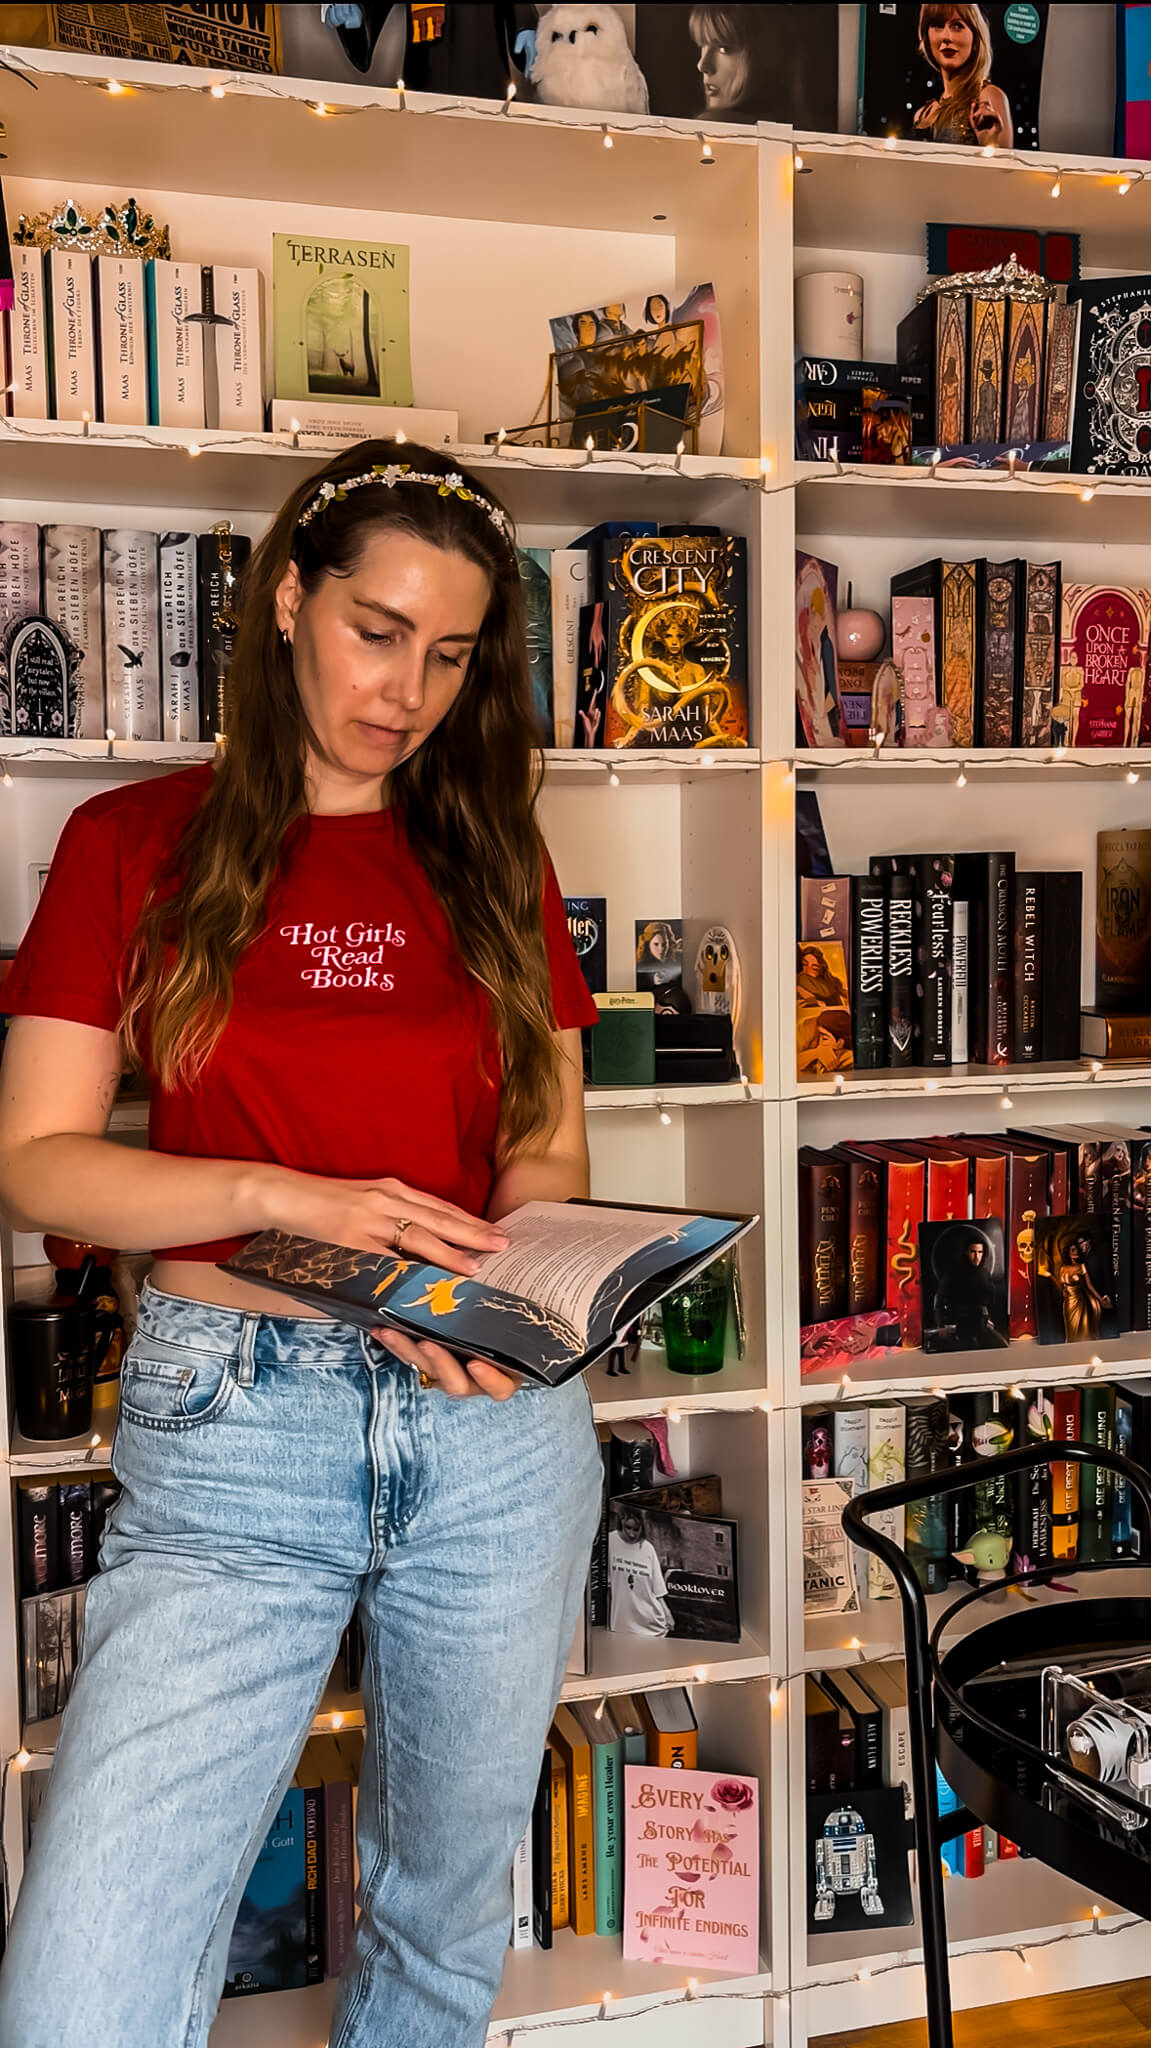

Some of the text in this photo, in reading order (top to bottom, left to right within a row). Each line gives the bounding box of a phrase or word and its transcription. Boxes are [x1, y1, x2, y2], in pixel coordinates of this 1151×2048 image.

[170, 34, 273, 73] MURDERED
[222, 38, 271, 62] FAMILY
[288, 243, 395, 269] TERRASEN
[66, 276, 74, 307] GLASS
[231, 291, 240, 321] GLASS
[62, 302, 75, 318] of
[16, 271, 33, 391] MAAS THRONE of GLASS
[68, 318, 77, 360] THRONE
[114, 281, 129, 400] MAAS THRONE of GLASS
[176, 327, 184, 368] THRONE
[233, 332, 242, 372] THRONE
[70, 370, 79, 396] MAAS
[235, 382, 243, 407] MAAS
[9, 539, 21, 571] HÖFE
[68, 543, 78, 573] HÖFE
[629, 549, 719, 565] CRESCENT
[58, 565, 67, 602] REICH
[164, 571, 173, 608] REICH
[211, 572, 219, 607] REICH
[633, 566, 715, 595] CITY
[69, 578, 79, 622] SIEBEN
[117, 569, 126, 628] DAS REICH
[128, 548, 139, 647] DER SIEBEN HÖFE
[175, 550, 186, 648] DER SIEBEN HÖFE
[567, 619, 575, 664] CRESCENT
[1086, 624, 1130, 644] ONCE
[1086, 643, 1114, 654] UPON
[1085, 654, 1128, 671] BROKEN
[1085, 668, 1127, 686] HEART
[136, 678, 144, 711] MAAS
[170, 683, 179, 721] SARAH
[182, 680, 191, 712] MAAS
[641, 705, 713, 723] SARAH J.
[1088, 718, 1117, 729] STEPHANIE
[650, 725, 703, 742] MAAS
[997, 879, 1008, 930] CRIMSON
[1024, 887, 1036, 929] REBEL
[1105, 888, 1140, 912] IRON
[280, 922, 406, 947] Hot Girls
[889, 899, 913, 977] RECKLESS
[927, 889, 952, 958] Fearless
[311, 945, 384, 971] Read
[860, 898, 883, 993] POWERLESS
[997, 933, 1008, 973] MOTH
[1023, 934, 1036, 982] WITCH
[953, 935, 967, 990] POWERFUL
[300, 966, 395, 991] Books
[1111, 1223, 1121, 1253] FALLEN
[807, 1506, 826, 1515] STAR
[1065, 1492, 1074, 1511] DIE
[1095, 1487, 1105, 1506] DIE
[1039, 1498, 1048, 1557] HARKNESS
[667, 1581, 725, 1598] BOOKLOVER
[804, 1576, 846, 1593] TANIC
[898, 1730, 906, 1767] ESCAPE
[605, 1754, 615, 1790] Healer
[576, 1773, 589, 1818] IMAGINE
[605, 1791, 615, 1814] own
[631, 1783, 704, 1811] EVERY
[306, 1816, 317, 1838] POOR
[605, 1816, 616, 1842] your
[638, 1820, 694, 1842] STORY
[271, 1836, 295, 1849] Gott
[306, 1839, 317, 1863] DAD
[605, 1843, 615, 1859] Be
[306, 1865, 318, 1890] RICH
[636, 1851, 751, 1878] THE POTENTIAL
[664, 1886, 706, 1909] FOR
[635, 1910, 749, 1938] INFINITE ENDINGS
